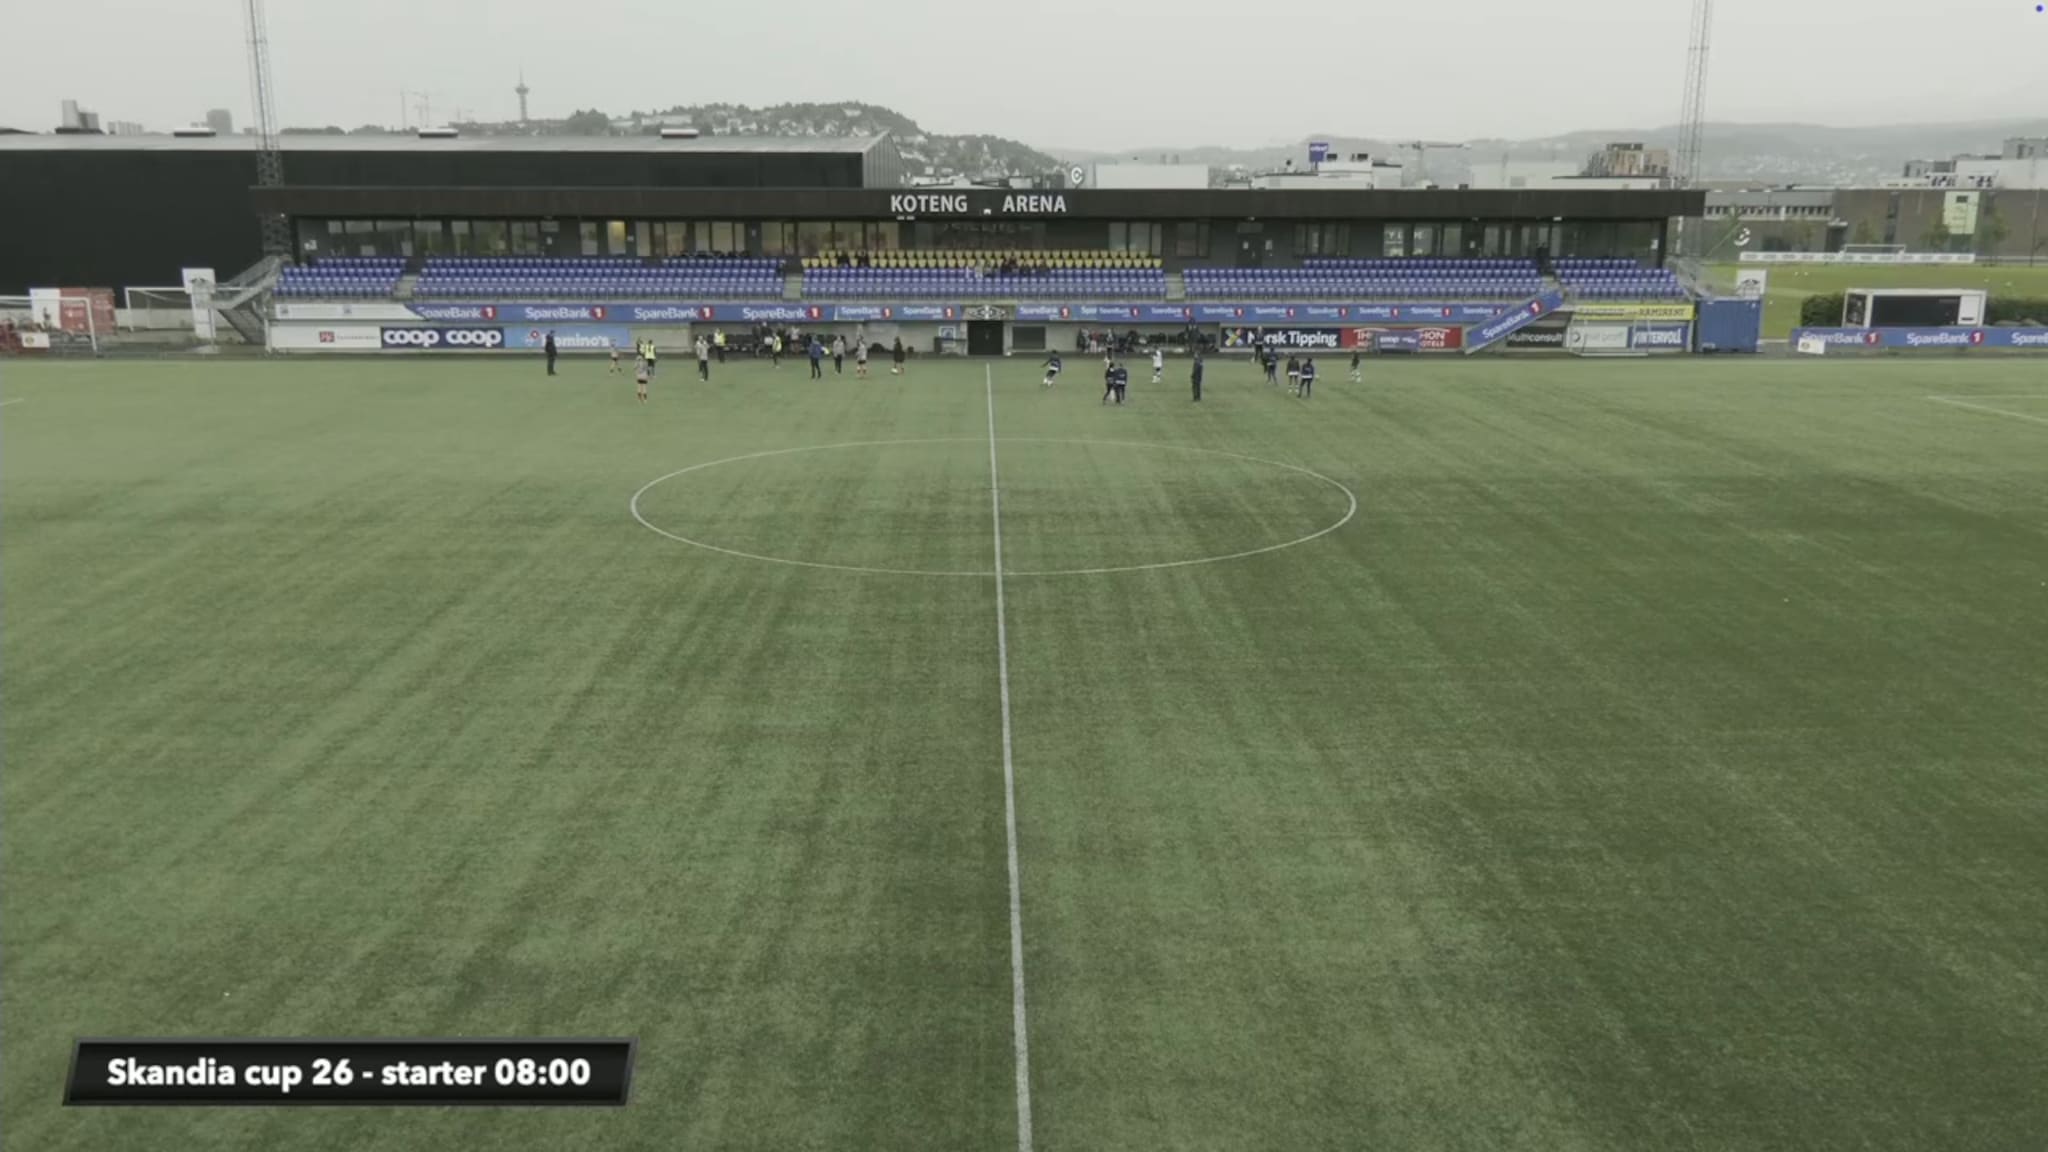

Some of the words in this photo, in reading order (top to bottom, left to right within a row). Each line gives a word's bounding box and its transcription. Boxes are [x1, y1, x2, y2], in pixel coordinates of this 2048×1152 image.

[890, 195, 968, 213] KOTENG
[1002, 195, 1067, 213] ARENA
[525, 307, 591, 320] SpareBank
[634, 307, 699, 320] SpareBank
[742, 307, 807, 320] SpareBank
[1482, 309, 1529, 339] SpareBank
[383, 329, 440, 347] coop
[445, 329, 502, 347] coop
[1288, 330, 1338, 347] Tipping
[1906, 332, 1969, 346] SpareBank
